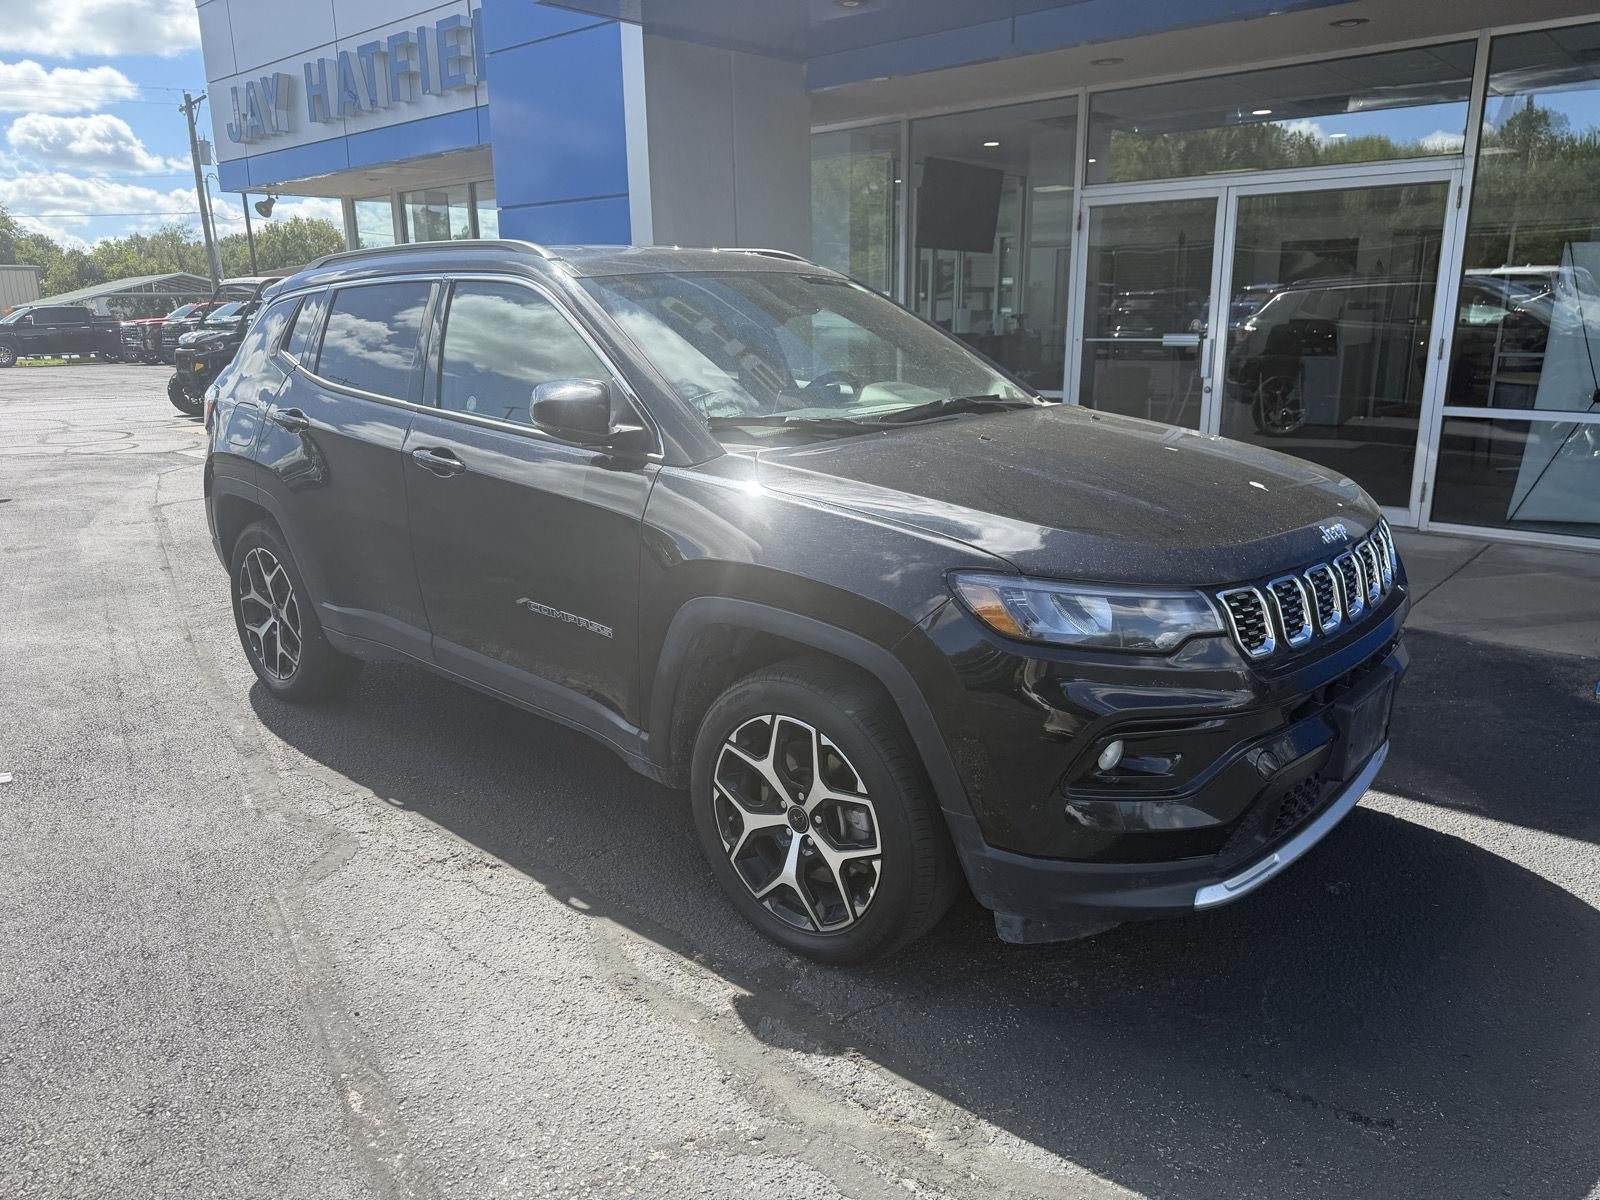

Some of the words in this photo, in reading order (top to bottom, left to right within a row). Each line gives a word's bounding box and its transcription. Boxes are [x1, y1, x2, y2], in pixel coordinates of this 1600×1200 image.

[226, 71, 291, 143] JAY
[1319, 523, 1347, 544] Jeep
[526, 600, 613, 639] COMPASS
